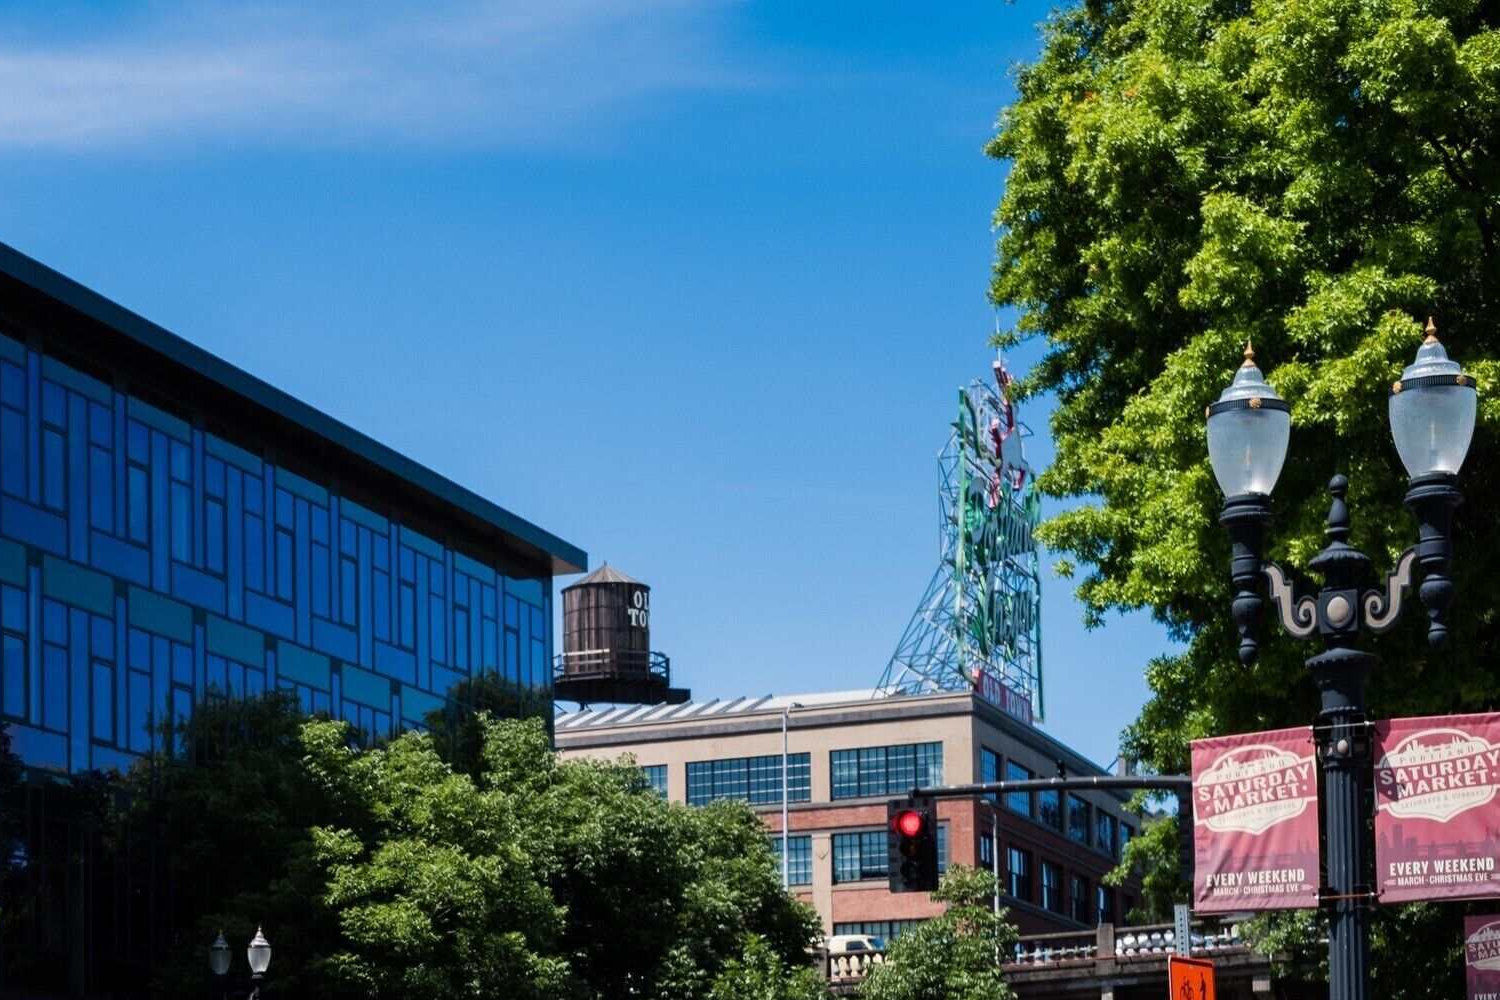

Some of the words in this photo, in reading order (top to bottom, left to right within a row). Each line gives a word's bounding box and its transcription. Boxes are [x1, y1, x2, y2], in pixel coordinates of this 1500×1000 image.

[627, 608, 649, 627] TO
[1400, 745, 1474, 764] PORTLAND
[1216, 760, 1286, 781] PORTLAND
[1380, 750, 1500, 785] SATURDAY
[1197, 763, 1310, 802] SATURDAY
[1397, 769, 1488, 799] MARKET
[1213, 782, 1300, 814] MARKET
[1389, 861, 1429, 876] EVERY
[1434, 857, 1495, 873] WEEKEND
[1206, 872, 1243, 887] EVERY
[1248, 868, 1305, 884] WEEKEND
[1398, 876, 1424, 886] MARCH
[1430, 873, 1473, 884] CHRISTMAS
[1475, 873, 1488, 882] EVE
[1213, 888, 1238, 897] MARCH
[1244, 885, 1284, 895] CHRISTMAS
[1287, 883, 1299, 892] EVE
